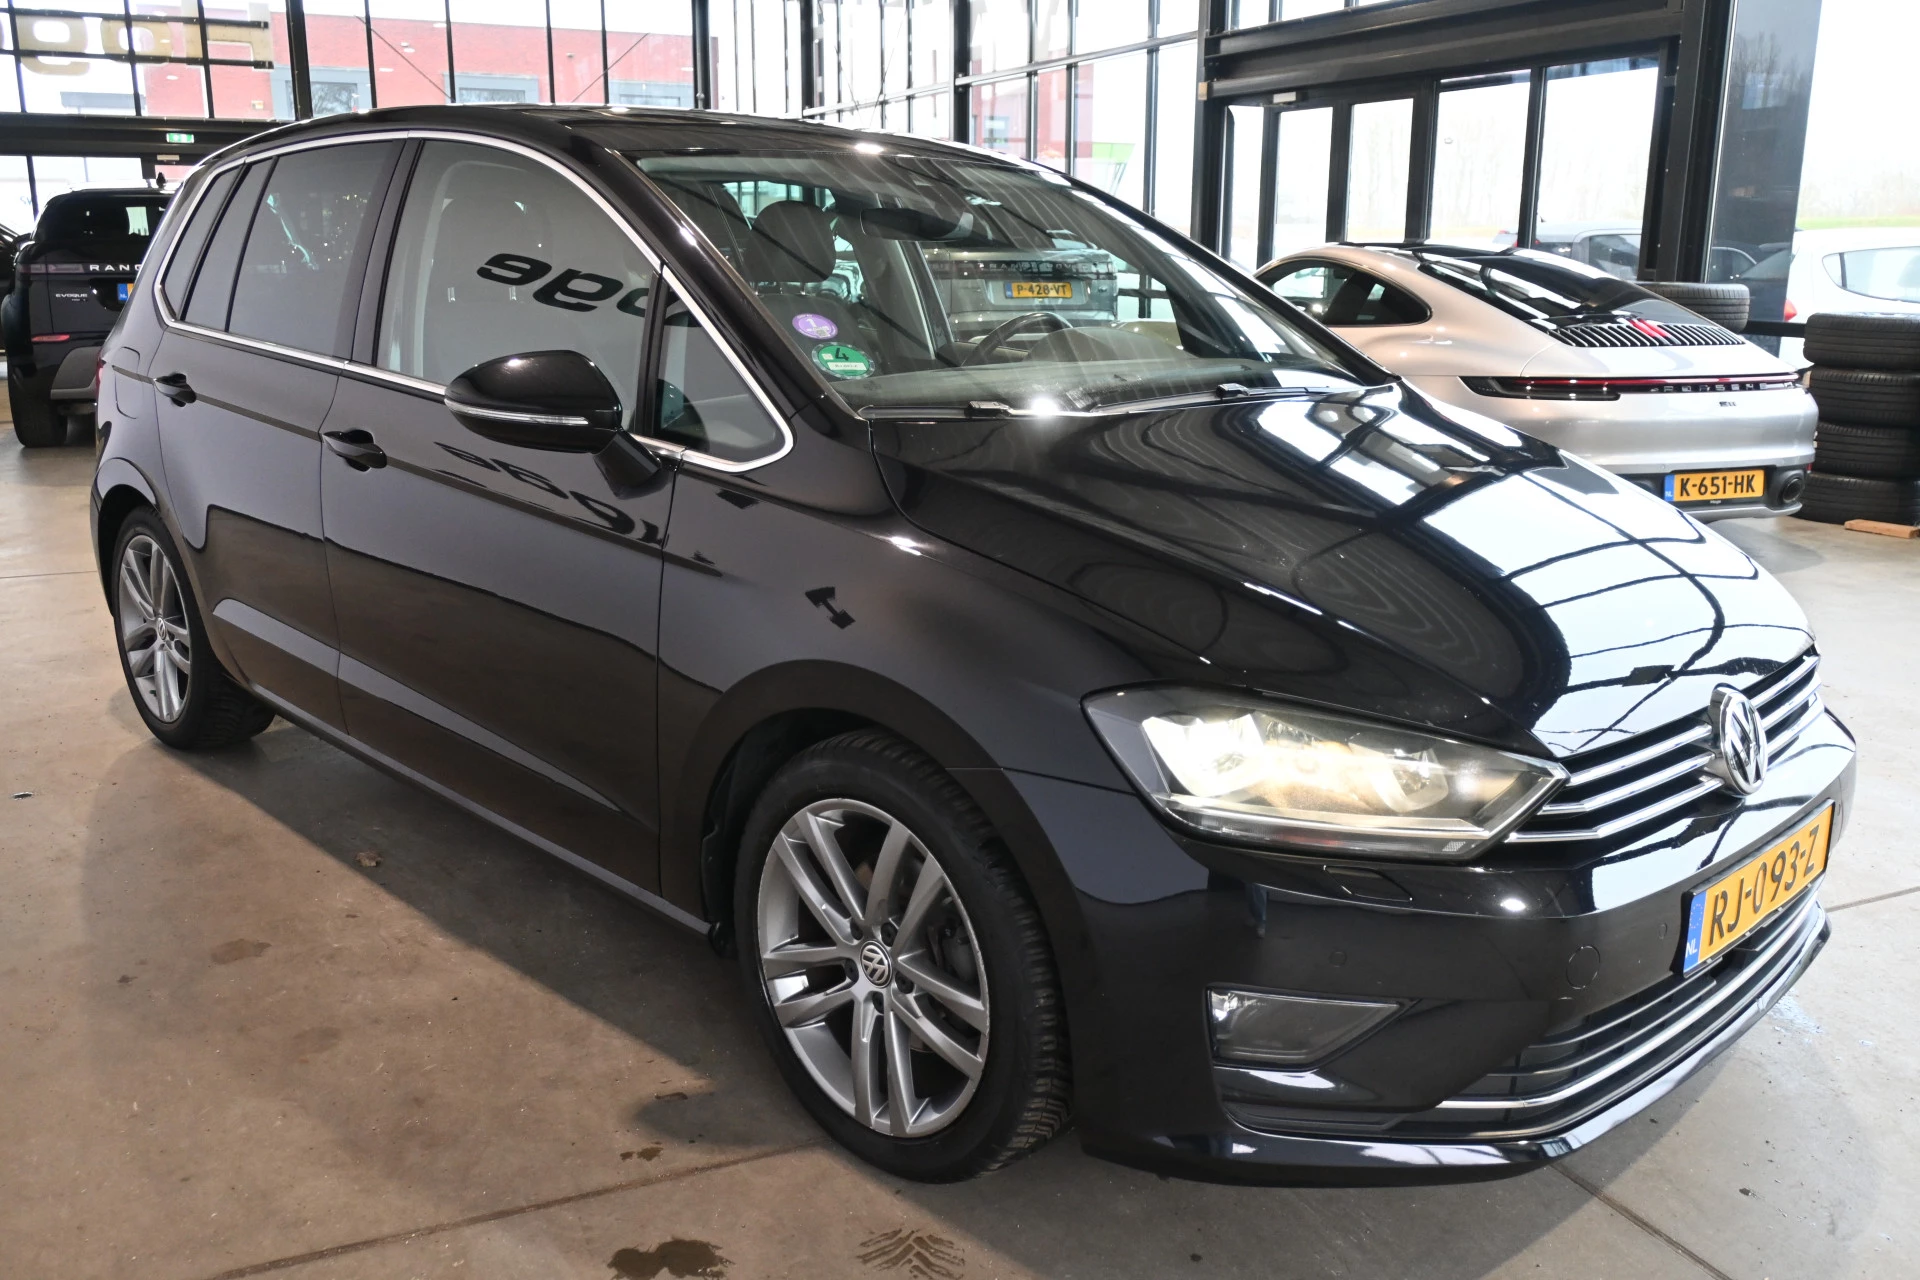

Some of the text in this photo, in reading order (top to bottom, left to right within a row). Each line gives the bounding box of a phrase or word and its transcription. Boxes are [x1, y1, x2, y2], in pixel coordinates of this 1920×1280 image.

[1017, 285, 1067, 296] P-428-VT
[835, 347, 850, 361] 4
[1680, 474, 1756, 497] K-651-HK
[1709, 824, 1820, 946] RJ-093-Z
[1685, 938, 1698, 958] NL
